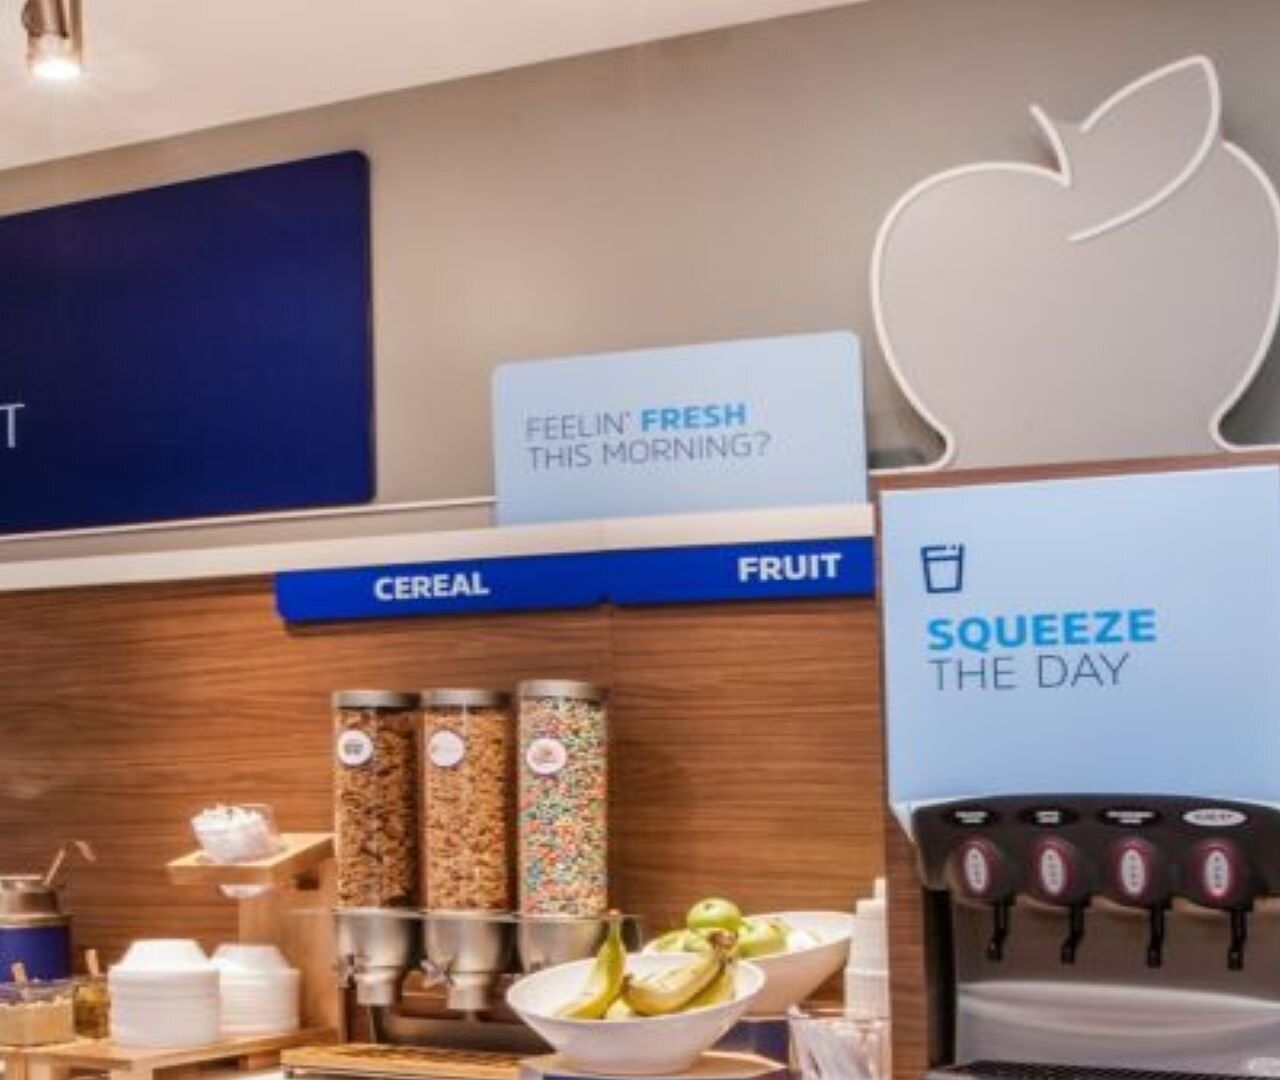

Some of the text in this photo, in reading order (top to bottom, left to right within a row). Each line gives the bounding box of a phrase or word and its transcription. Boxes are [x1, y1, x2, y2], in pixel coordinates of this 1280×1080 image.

[640, 404, 746, 431] FRESH
[529, 431, 771, 469] THIS MORNING?
[738, 552, 842, 582] FRUIT
[374, 572, 490, 600] CEREAL
[927, 609, 1157, 652] SQUEEZE
[927, 652, 1130, 690] THE DAY
